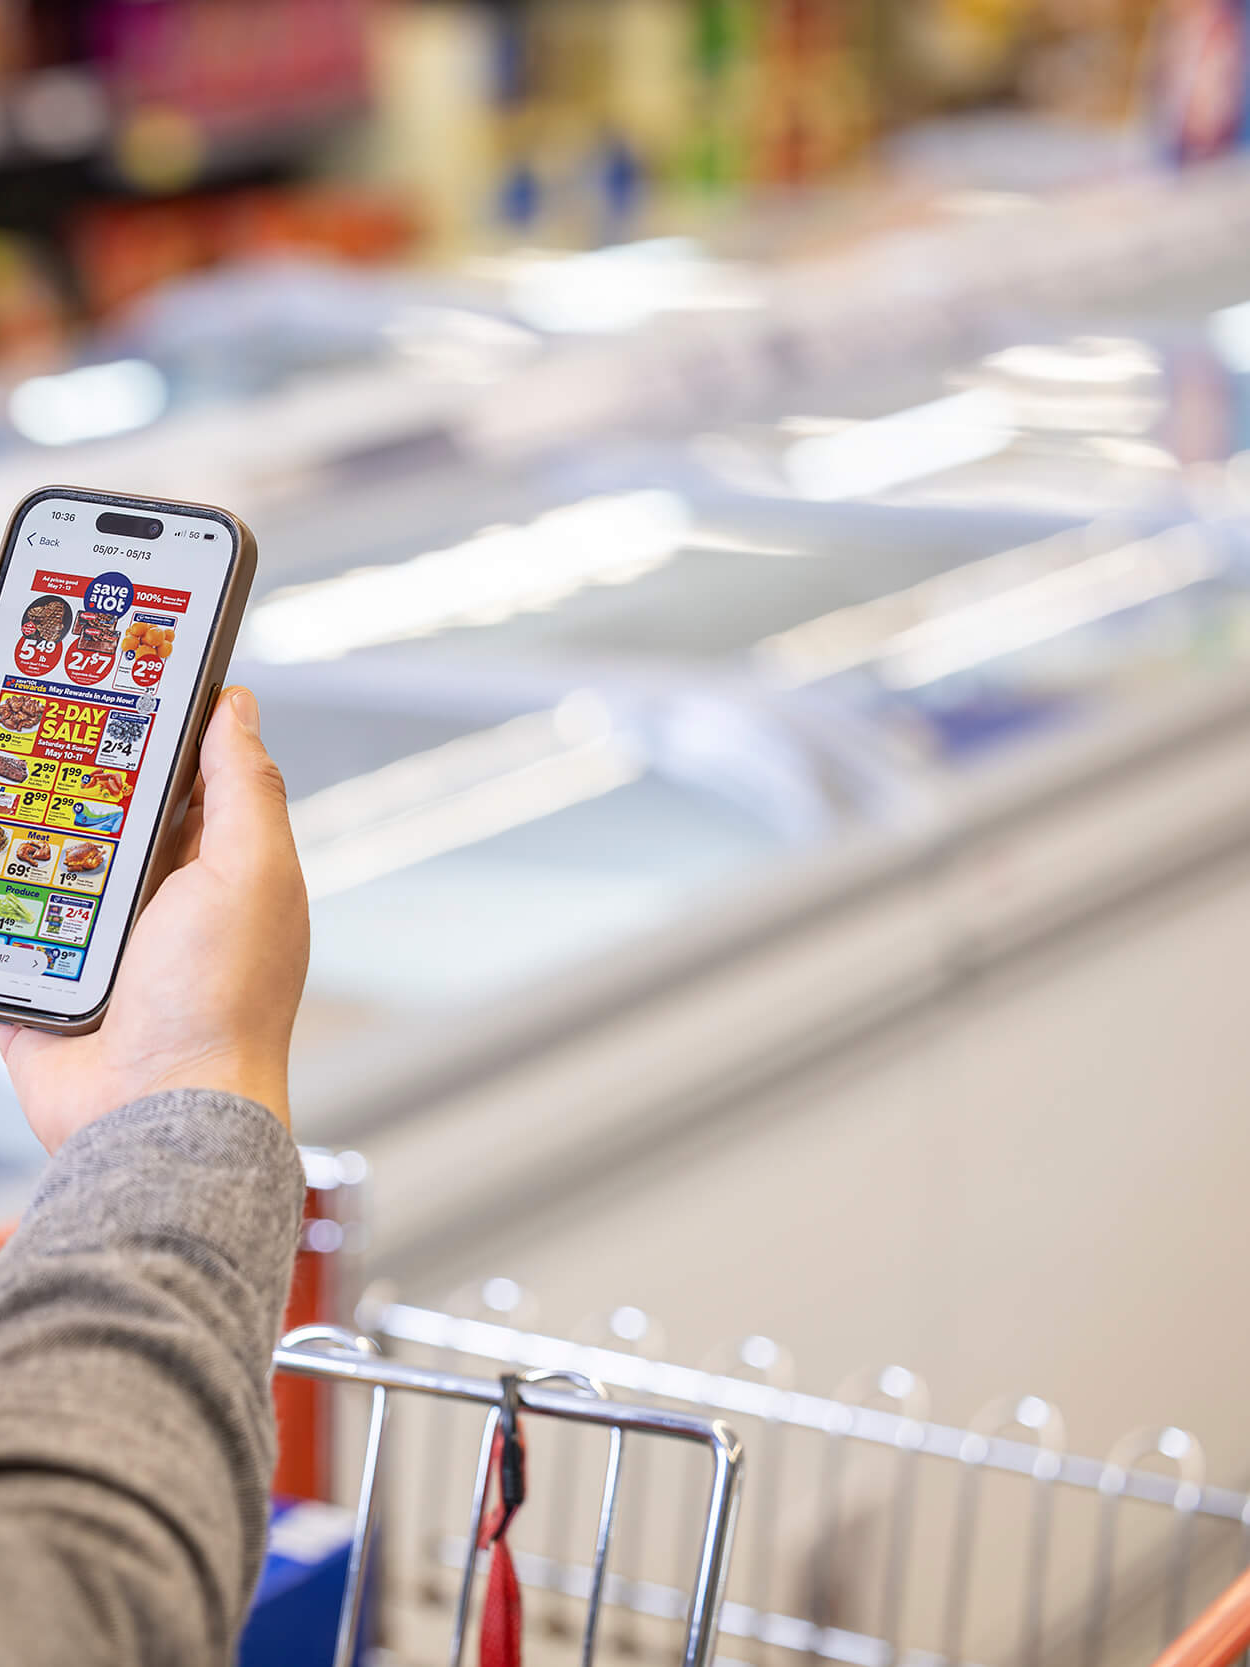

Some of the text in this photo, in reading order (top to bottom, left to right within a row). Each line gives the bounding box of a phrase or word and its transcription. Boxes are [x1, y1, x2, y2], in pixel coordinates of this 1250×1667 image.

[52, 511, 76, 522] 10:36
[39, 537, 61, 547] Back
[189, 531, 200, 540] 5G
[93, 544, 119, 556] 05/07
[126, 549, 151, 560] 05/13
[92, 583, 129, 598] save
[136, 591, 162, 603] 100%
[90, 594, 97, 602] a
[68, 651, 112, 674] 2/$7
[14, 683, 46, 692] rewards
[48, 685, 64, 696] May
[63, 687, 93, 698] Rewards
[101, 694, 116, 703] App
[116, 696, 135, 705] Now!
[45, 702, 107, 726] 2-DAY
[40, 719, 101, 746] SALE
[37, 739, 65, 750] Saturday
[71, 744, 95, 754] Sunday
[101, 740, 132, 756] 2/$4
[44, 749, 83, 762] May 10-11
[27, 831, 50, 842] Meat
[5, 885, 40, 898] Produce
[65, 907, 90, 921] 2/$4
[0, 954, 10, 963] 1/2
